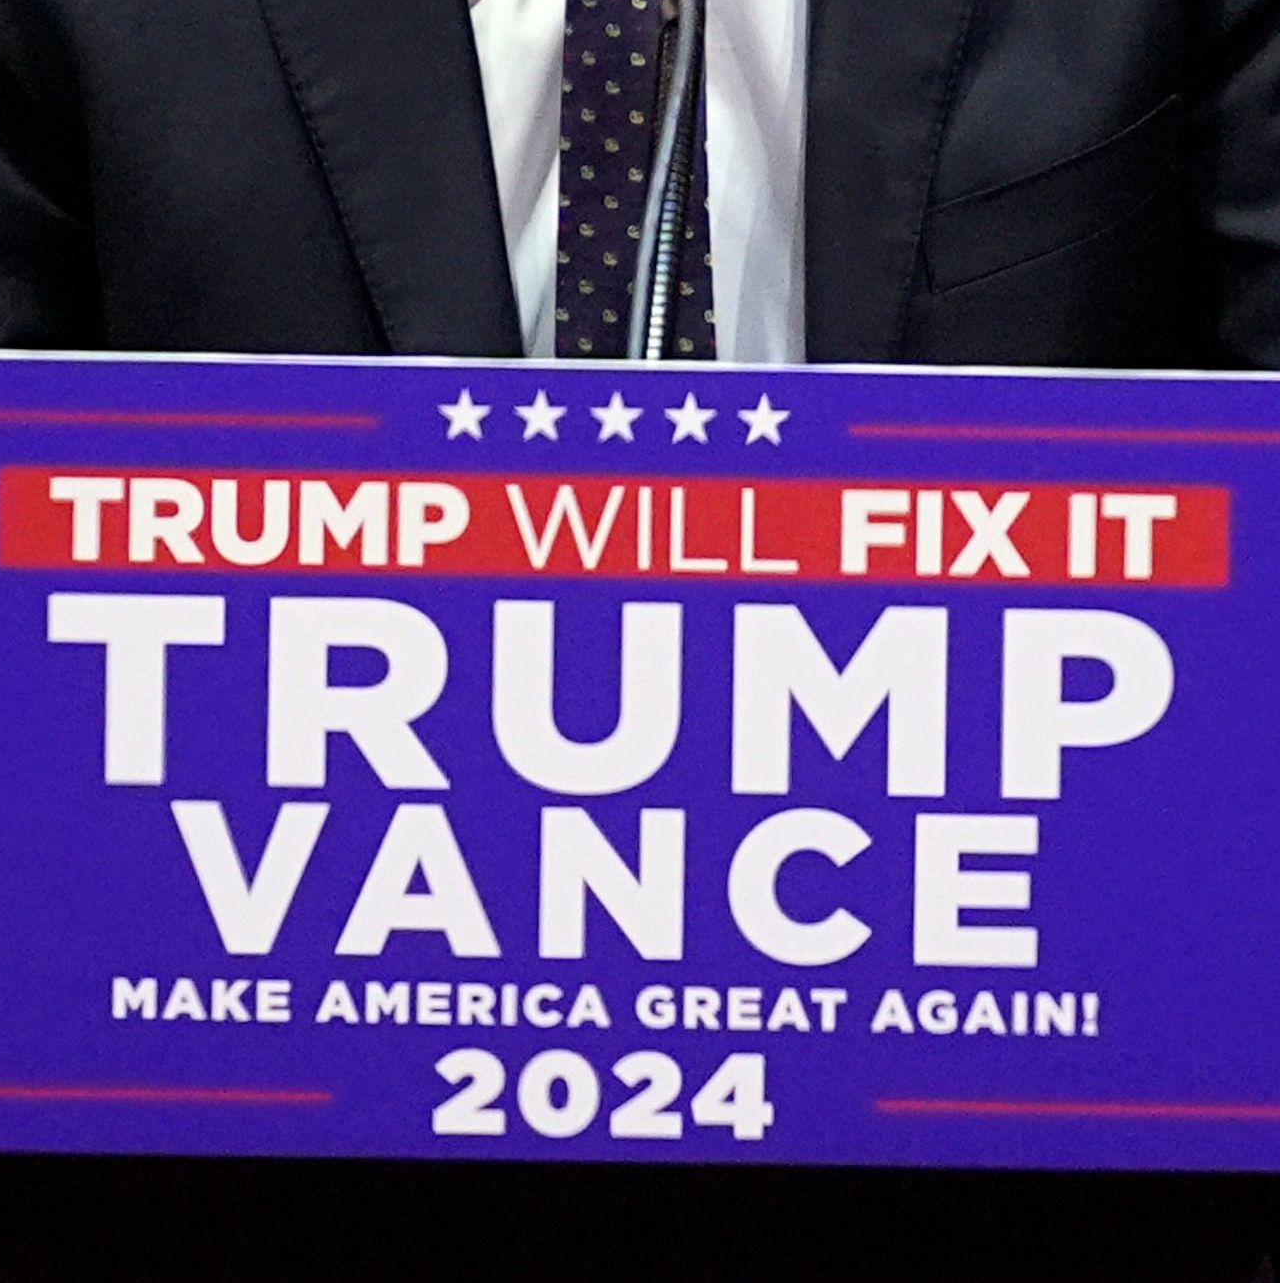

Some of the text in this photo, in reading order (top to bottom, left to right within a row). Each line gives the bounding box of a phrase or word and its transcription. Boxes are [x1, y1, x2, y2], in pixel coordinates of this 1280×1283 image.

[49, 476, 1178, 580] TRUMP WILL FIX IT
[47, 592, 1174, 800] TRUMP
[170, 800, 1039, 968] VANCE
[112, 977, 1099, 1036] MAKE AMERICA GREAT AGAIN!
[432, 1048, 774, 1140] 2024
